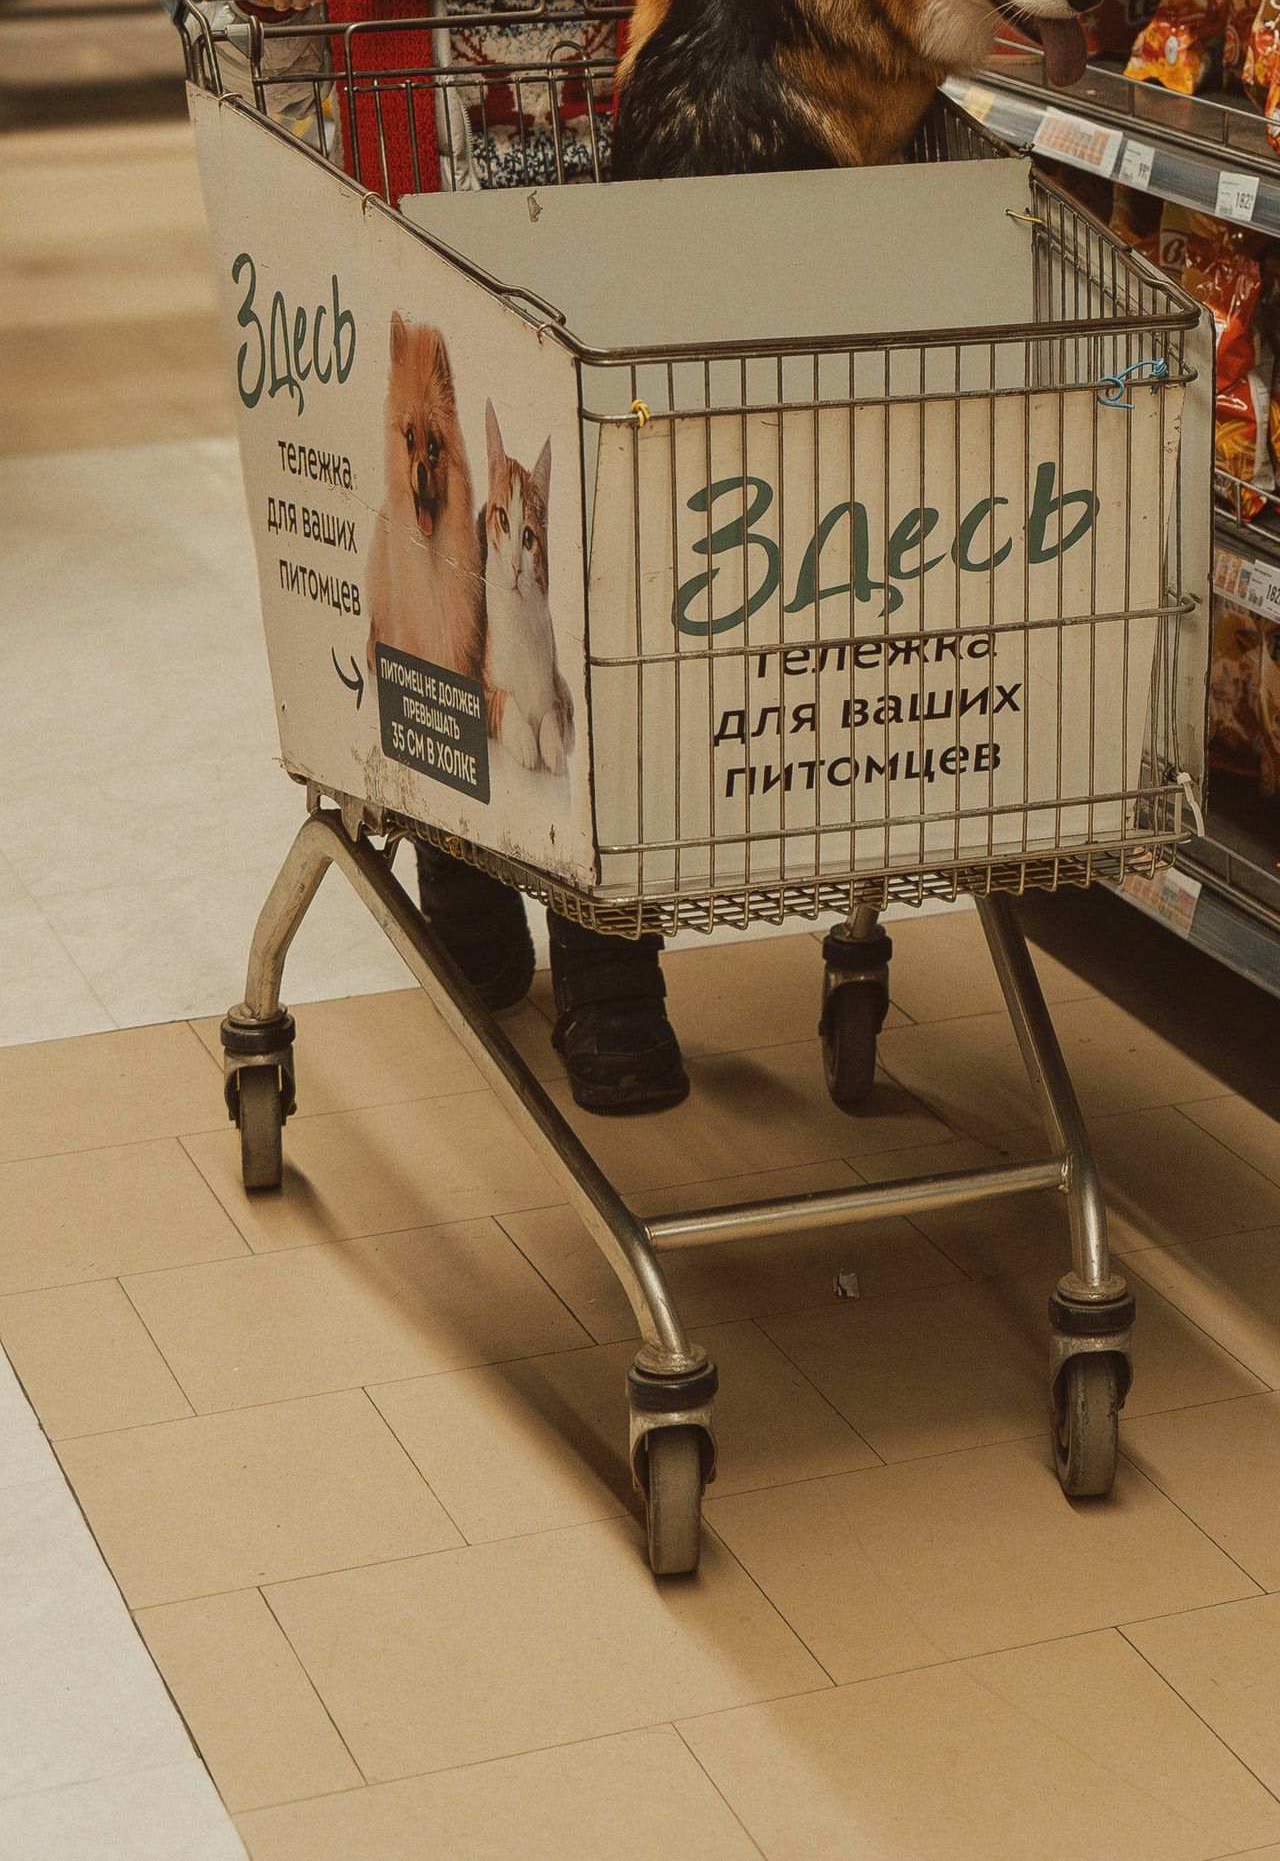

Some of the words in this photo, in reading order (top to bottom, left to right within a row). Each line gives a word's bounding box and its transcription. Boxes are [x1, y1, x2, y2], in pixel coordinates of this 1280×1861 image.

[231, 252, 357, 417] Здесь
[277, 439, 353, 490] тележка
[266, 496, 298, 536] для
[302, 508, 358, 554] ваших
[671, 461, 1101, 637] Здесь
[278, 558, 361, 616] питомцев
[380, 657, 424, 697] ПИТОМЕЦ
[425, 675, 437, 701] НЕ
[438, 681, 481, 719] ДОЛЖЕН
[402, 695, 461, 740] ПРЕВЫШАТЬ
[713, 701, 819, 748] для
[840, 682, 1024, 729] ваших
[391, 721, 406, 752] 35
[406, 728, 425, 761] СМ
[426, 736, 435, 766] В
[436, 740, 478, 786] ХОЛКЕ
[724, 741, 1003, 798] питомцев
